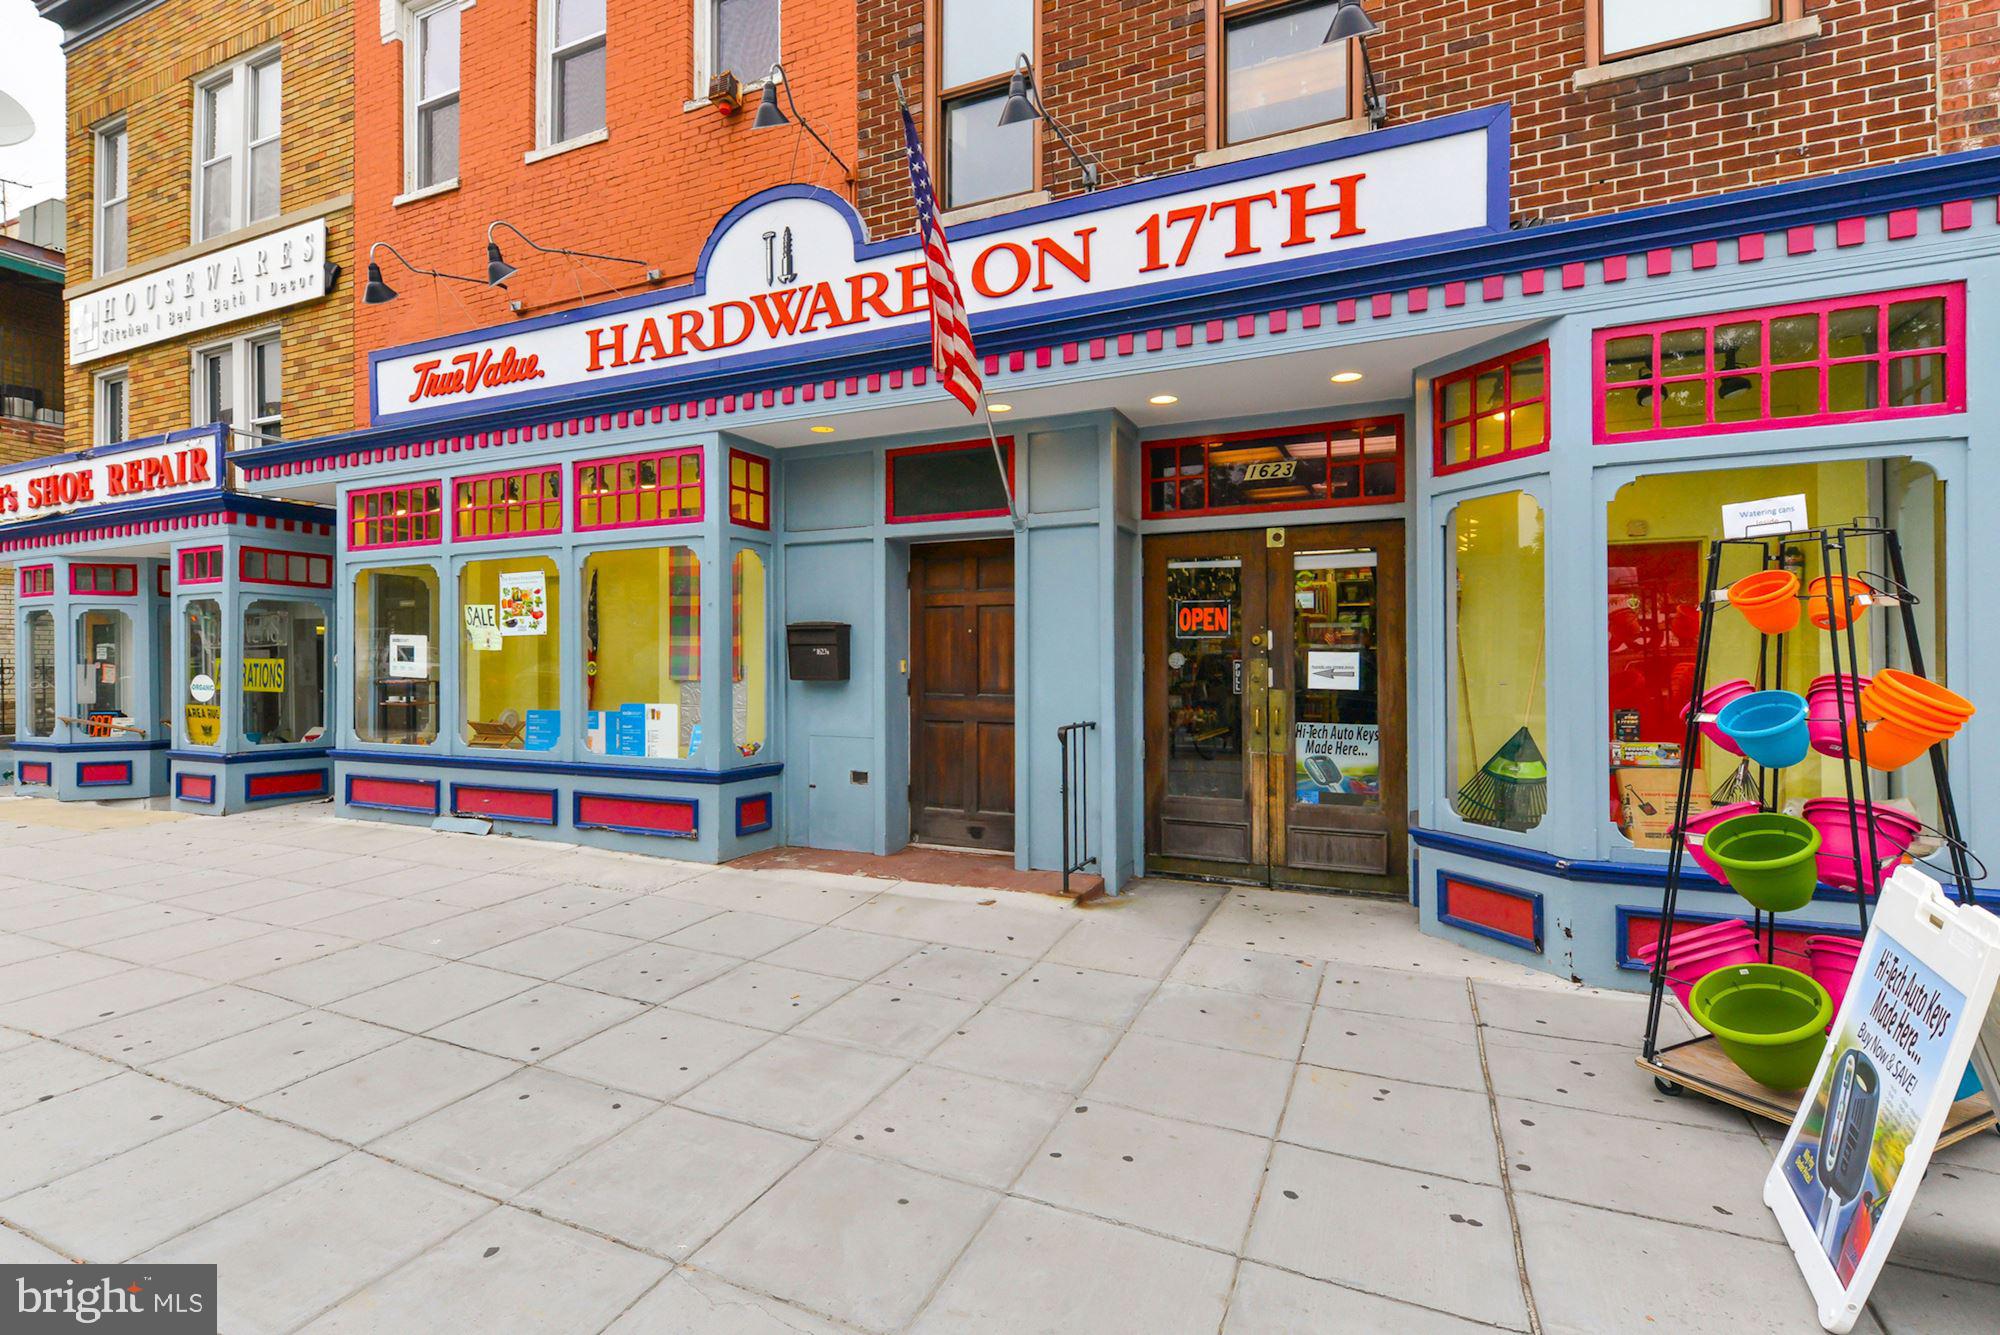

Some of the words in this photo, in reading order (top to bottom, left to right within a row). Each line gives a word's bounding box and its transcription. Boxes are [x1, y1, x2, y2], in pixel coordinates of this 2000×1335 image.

[103, 233, 315, 324] HOUSEWARES
[585, 262, 932, 373] HARDWARE
[971, 226, 1097, 299] ON
[1136, 172, 1367, 274] 17TH
[102, 323, 149, 345] Kitchen
[168, 306, 192, 326] Bed
[213, 291, 246, 313] Bath
[270, 273, 315, 297] Decor
[28, 469, 94, 509] SHOE
[106, 447, 211, 497] REPAIR
[1250, 463, 1293, 479] 1623
[1739, 508, 1777, 518] Watering
[1778, 505, 1796, 514] cans
[466, 606, 495, 627] SALE
[1179, 607, 1228, 632] OPEN
[187, 708, 206, 719] AREA
[1295, 724, 1329, 739] Hi-Tech
[1330, 725, 1354, 740] Auto
[1356, 726, 1379, 744] Keys
[1305, 740, 1333, 755] Made
[1335, 741, 1368, 756] Here...
[1874, 948, 1909, 999] Hi-Tech
[1901, 972, 1928, 1016] Auto
[1923, 989, 1951, 1041] Keys
[1869, 988, 1898, 1035] Made
[1892, 1009, 1921, 1065] Here...
[1857, 1022, 1871, 1049] Buy
[1870, 1035, 1889, 1065] Now
[1886, 1053, 1896, 1071] &
[1892, 1060, 1918, 1096] SAVE!
